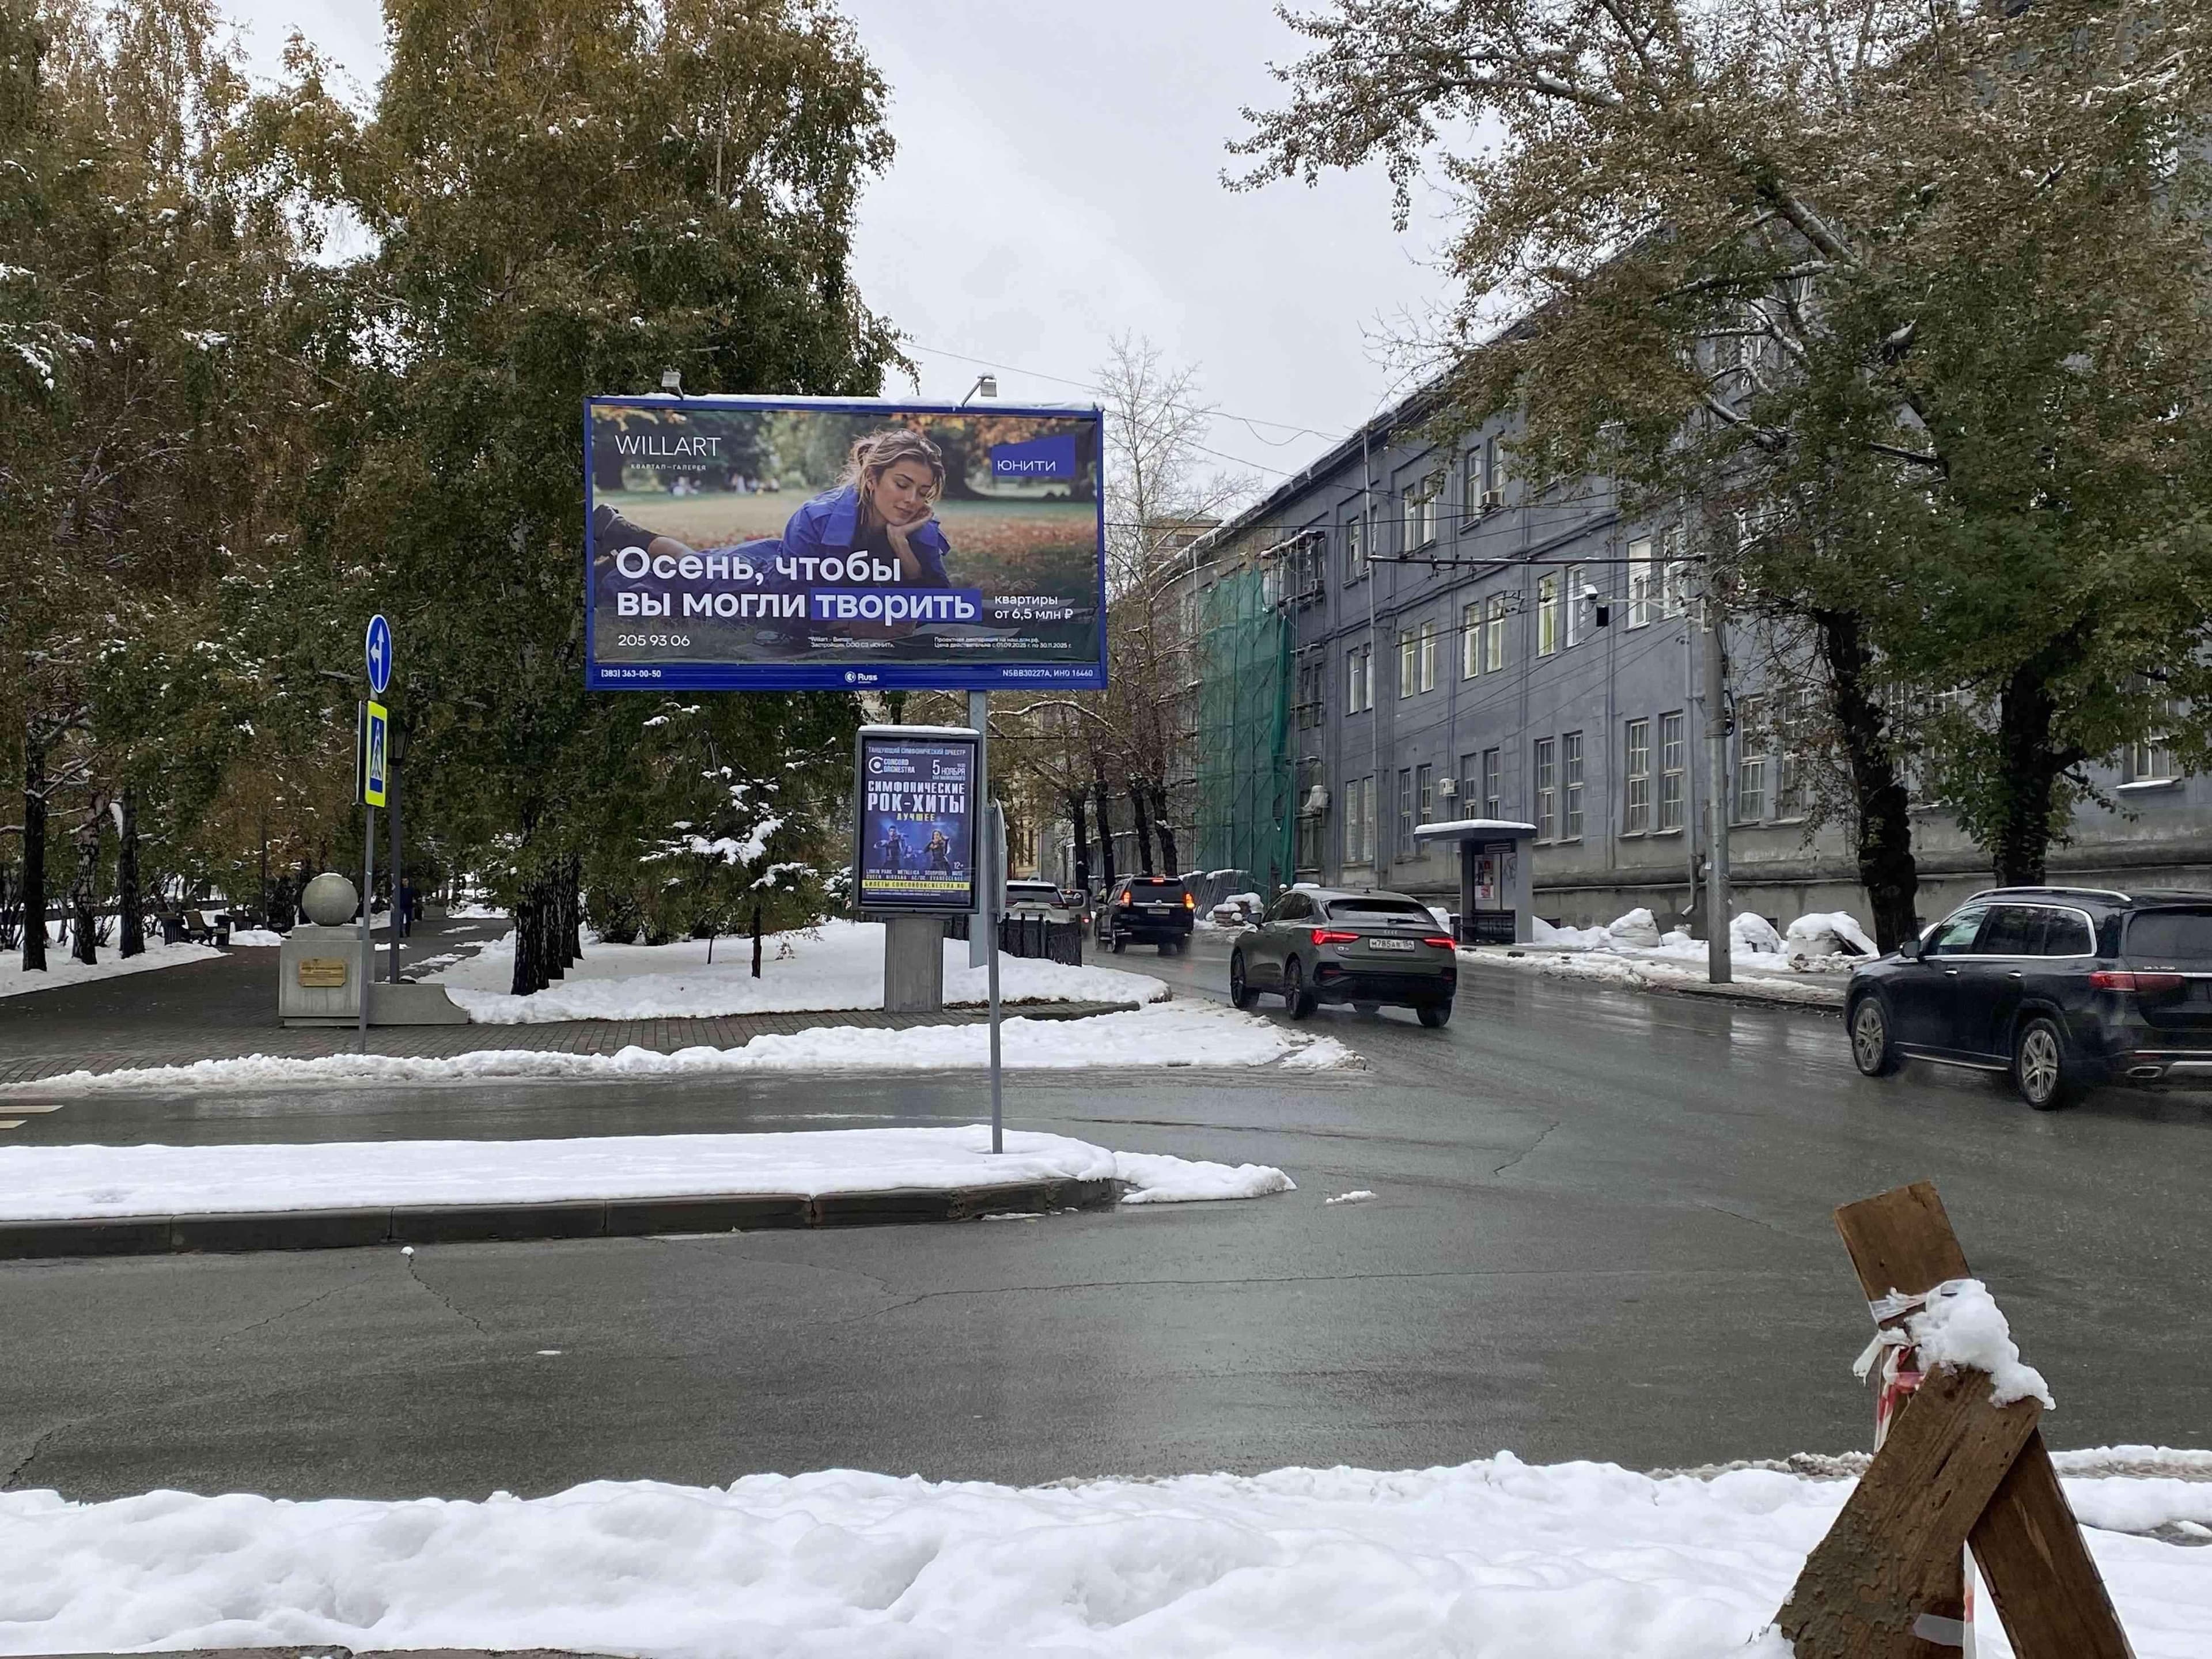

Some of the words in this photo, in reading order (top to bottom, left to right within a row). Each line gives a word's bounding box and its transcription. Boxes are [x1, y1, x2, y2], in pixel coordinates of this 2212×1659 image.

[615, 435, 722, 457] WILLART
[997, 460, 1056, 472] ЮНИТИ
[615, 546, 764, 586] Осень,
[775, 550, 900, 581] чтобы
[994, 595, 1058, 607] квартиры
[617, 593, 671, 617] вы
[683, 593, 805, 618] могли
[815, 594, 975, 627] творить
[994, 609, 1009, 619] от
[1012, 608, 1032, 620] 6,5
[1035, 610, 1061, 620] млн
[618, 634, 646, 646] 205
[649, 635, 668, 646] 93
[670, 635, 691, 647] 06
[622, 669, 661, 677] 363-00-50
[858, 673, 878, 681] Russ
[932, 759, 940, 775] 5
[941, 767, 966, 776] НОЯБРЯ
[868, 780, 965, 794] СИМФОНИЧЕСКИЕ
[867, 793, 965, 813] РОК-ХИТЫ
[896, 813, 935, 821] ЛУЧШЕЕ
